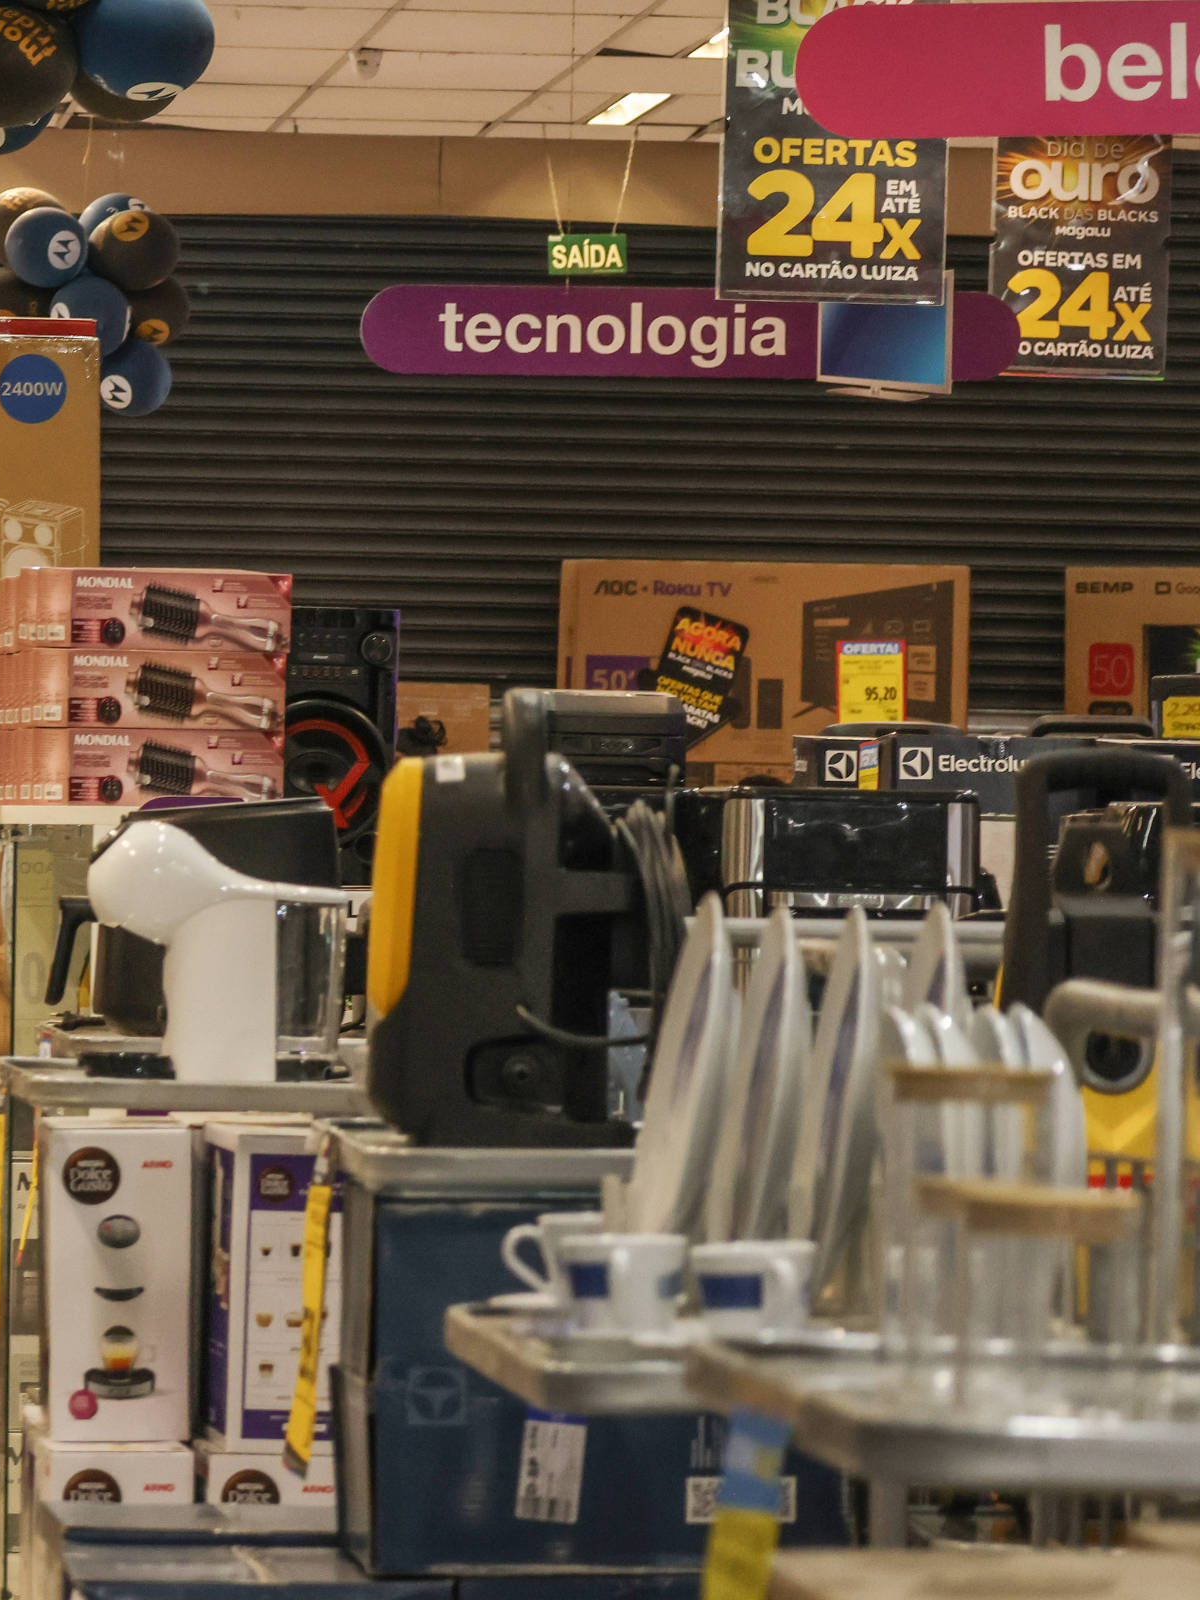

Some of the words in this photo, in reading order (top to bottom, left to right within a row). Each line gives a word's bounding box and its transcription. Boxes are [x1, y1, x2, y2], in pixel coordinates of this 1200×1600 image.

[1044, 22, 1200, 102] bel
[753, 136, 918, 168] OFERTAS
[886, 179, 917, 196] EM
[880, 193, 921, 214] ATÉ
[1007, 205, 1060, 220] BLACK
[1063, 207, 1094, 221] DAS
[1097, 209, 1159, 223] BLACKS
[552, 238, 623, 269] SAÍDA
[1017, 249, 1109, 269] OFERTAS
[1112, 253, 1142, 270] EM
[745, 262, 776, 278] NO
[778, 260, 858, 280] CARTÃO
[861, 263, 919, 281] LUIZA
[1113, 282, 1152, 303] ATÉ
[439, 302, 787, 368] tecnologia
[1034, 341, 1102, 358] CARTÃO
[1104, 344, 1154, 360] LUIZA
[1, 382, 63, 396] 2400W
[76, 576, 134, 589] MONDIAL
[706, 582, 733, 597] TV
[1075, 582, 1134, 594] SEMP
[675, 617, 741, 651] AGORA
[73, 656, 129, 667] MONDIAL
[671, 636, 735, 671] NUNCA
[74, 735, 131, 747] MONDIAL
[938, 754, 1030, 773] Electrolu
